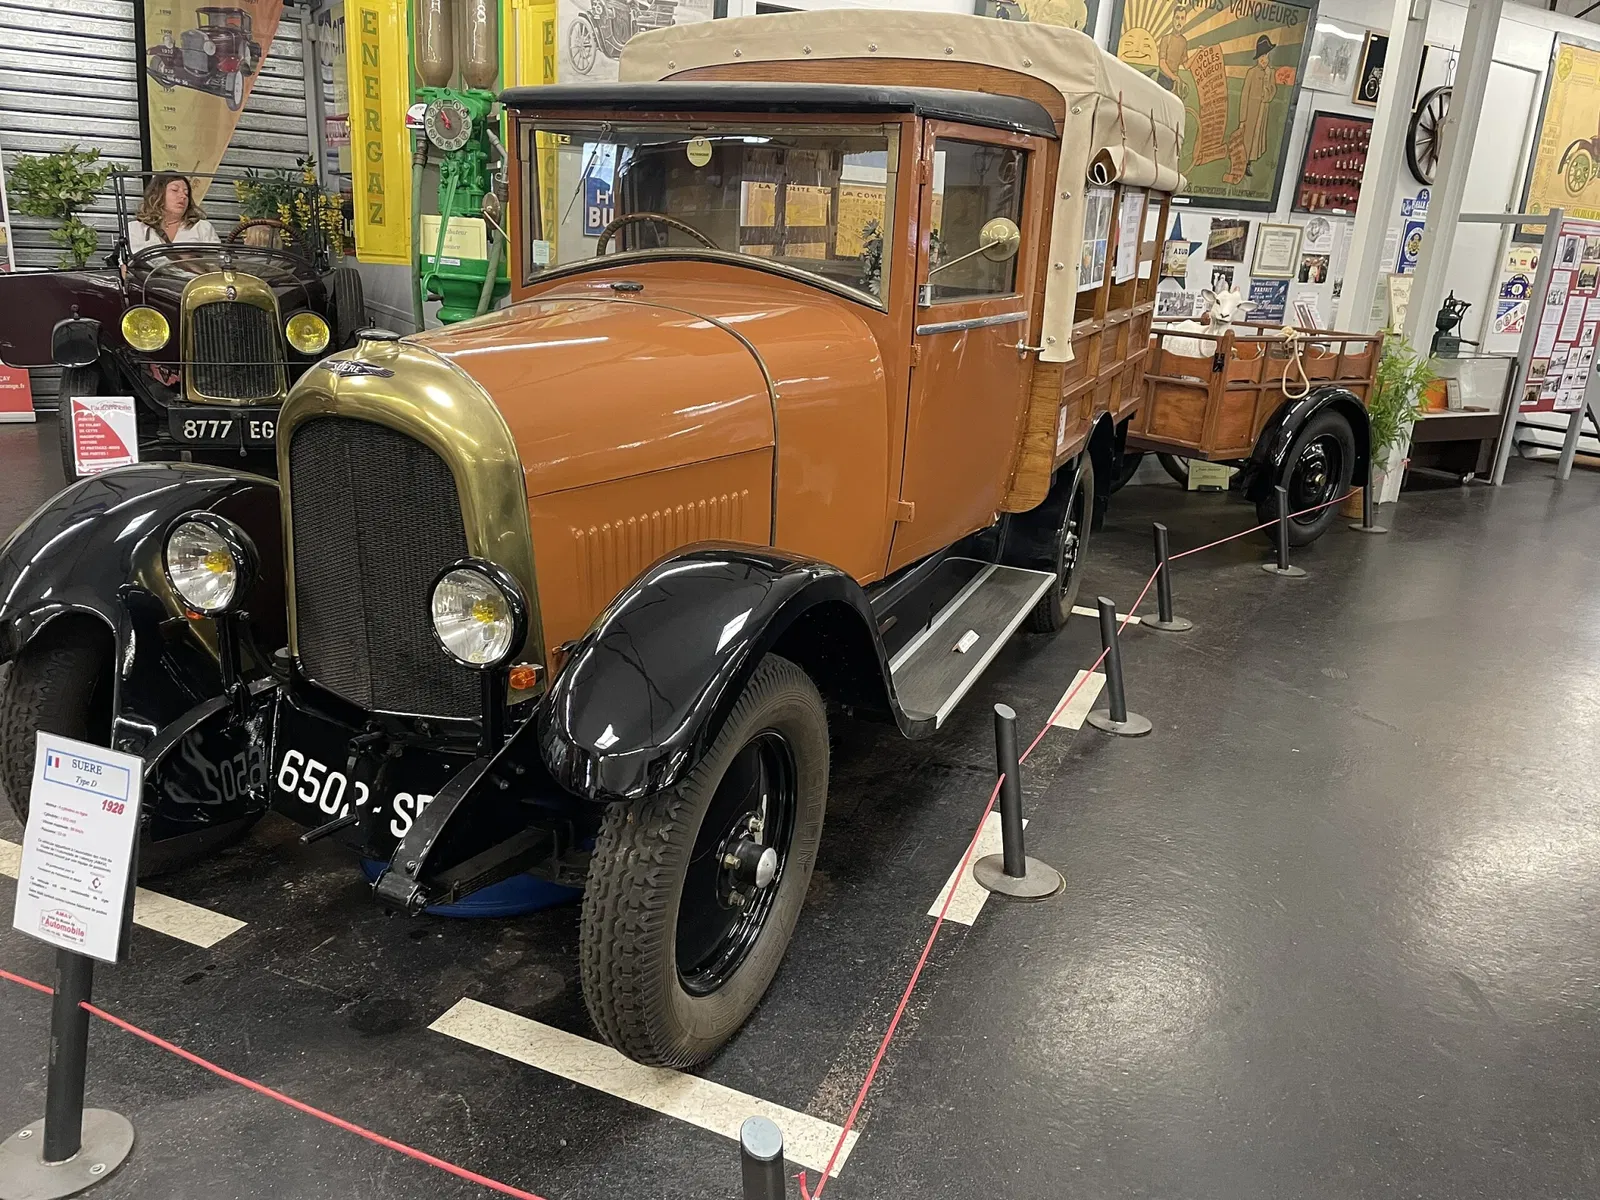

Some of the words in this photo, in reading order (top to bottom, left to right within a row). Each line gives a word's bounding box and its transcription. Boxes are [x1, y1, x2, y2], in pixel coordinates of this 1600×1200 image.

[1230, 0, 1299, 27] VAINQUEURS
[1195, 53, 1220, 76] CYCLES
[1196, 48, 1214, 63] 1908
[1196, 63, 1222, 85] PEUGEOT
[361, 11, 385, 224] ENERGAZ
[183, 419, 233, 439] 8777
[249, 420, 275, 439] EG
[71, 759, 103, 776] SUERE
[75, 776, 91, 788] Type
[90, 779, 98, 788] D
[101, 799, 125, 815] 1928
[42, 916, 85, 937] l'Automobile
